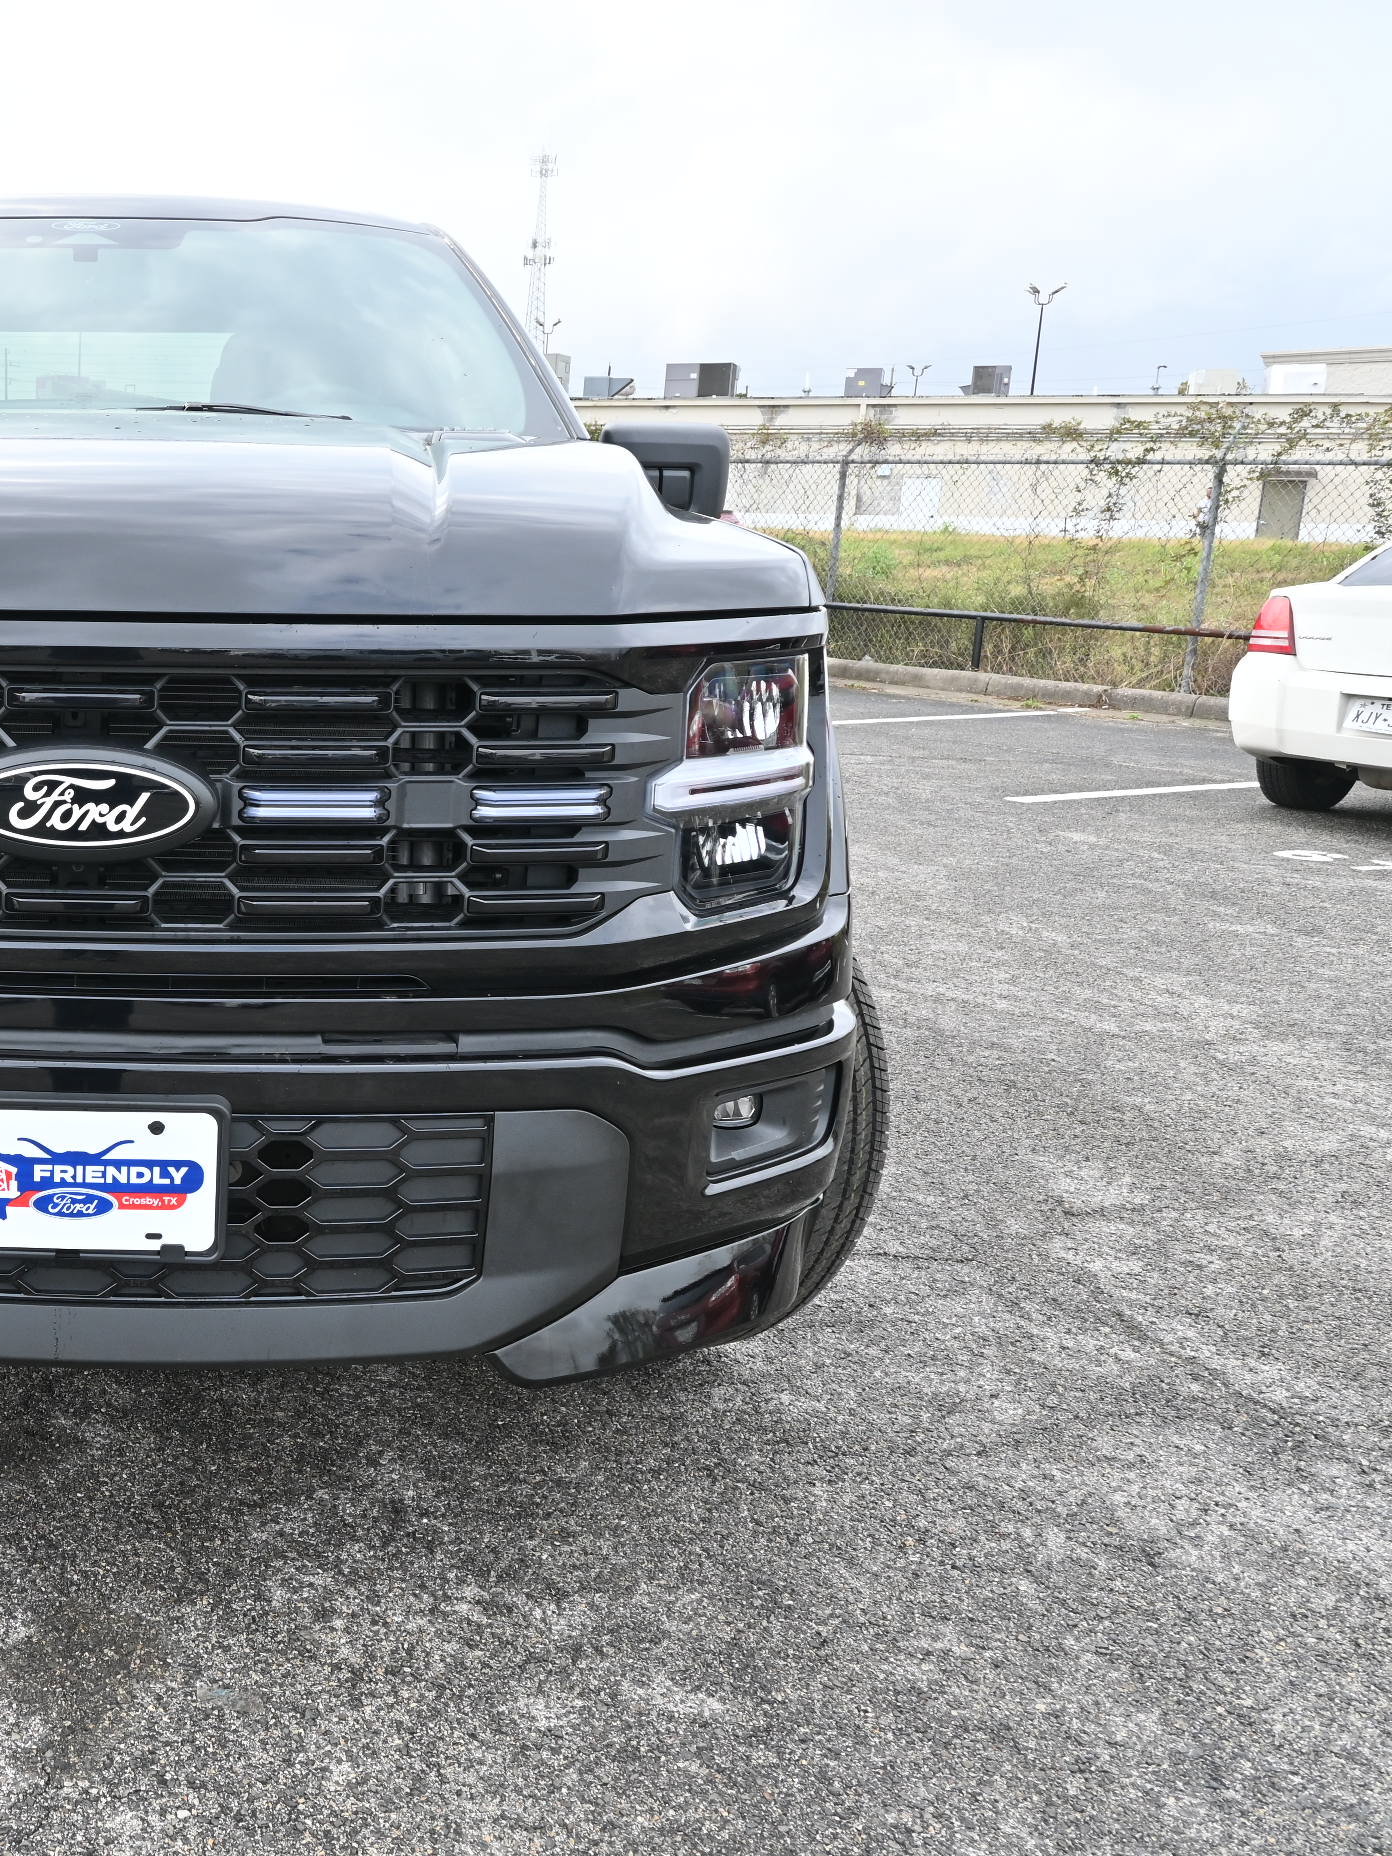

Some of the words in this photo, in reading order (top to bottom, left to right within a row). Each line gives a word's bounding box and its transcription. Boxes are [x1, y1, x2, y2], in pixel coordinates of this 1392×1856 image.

[8, 774, 151, 833] Ford
[33, 1164, 188, 1185] FRIENDLY
[47, 1193, 97, 1214] Ford
[121, 1196, 162, 1206] Crosby,
[163, 1197, 178, 1206] TX
